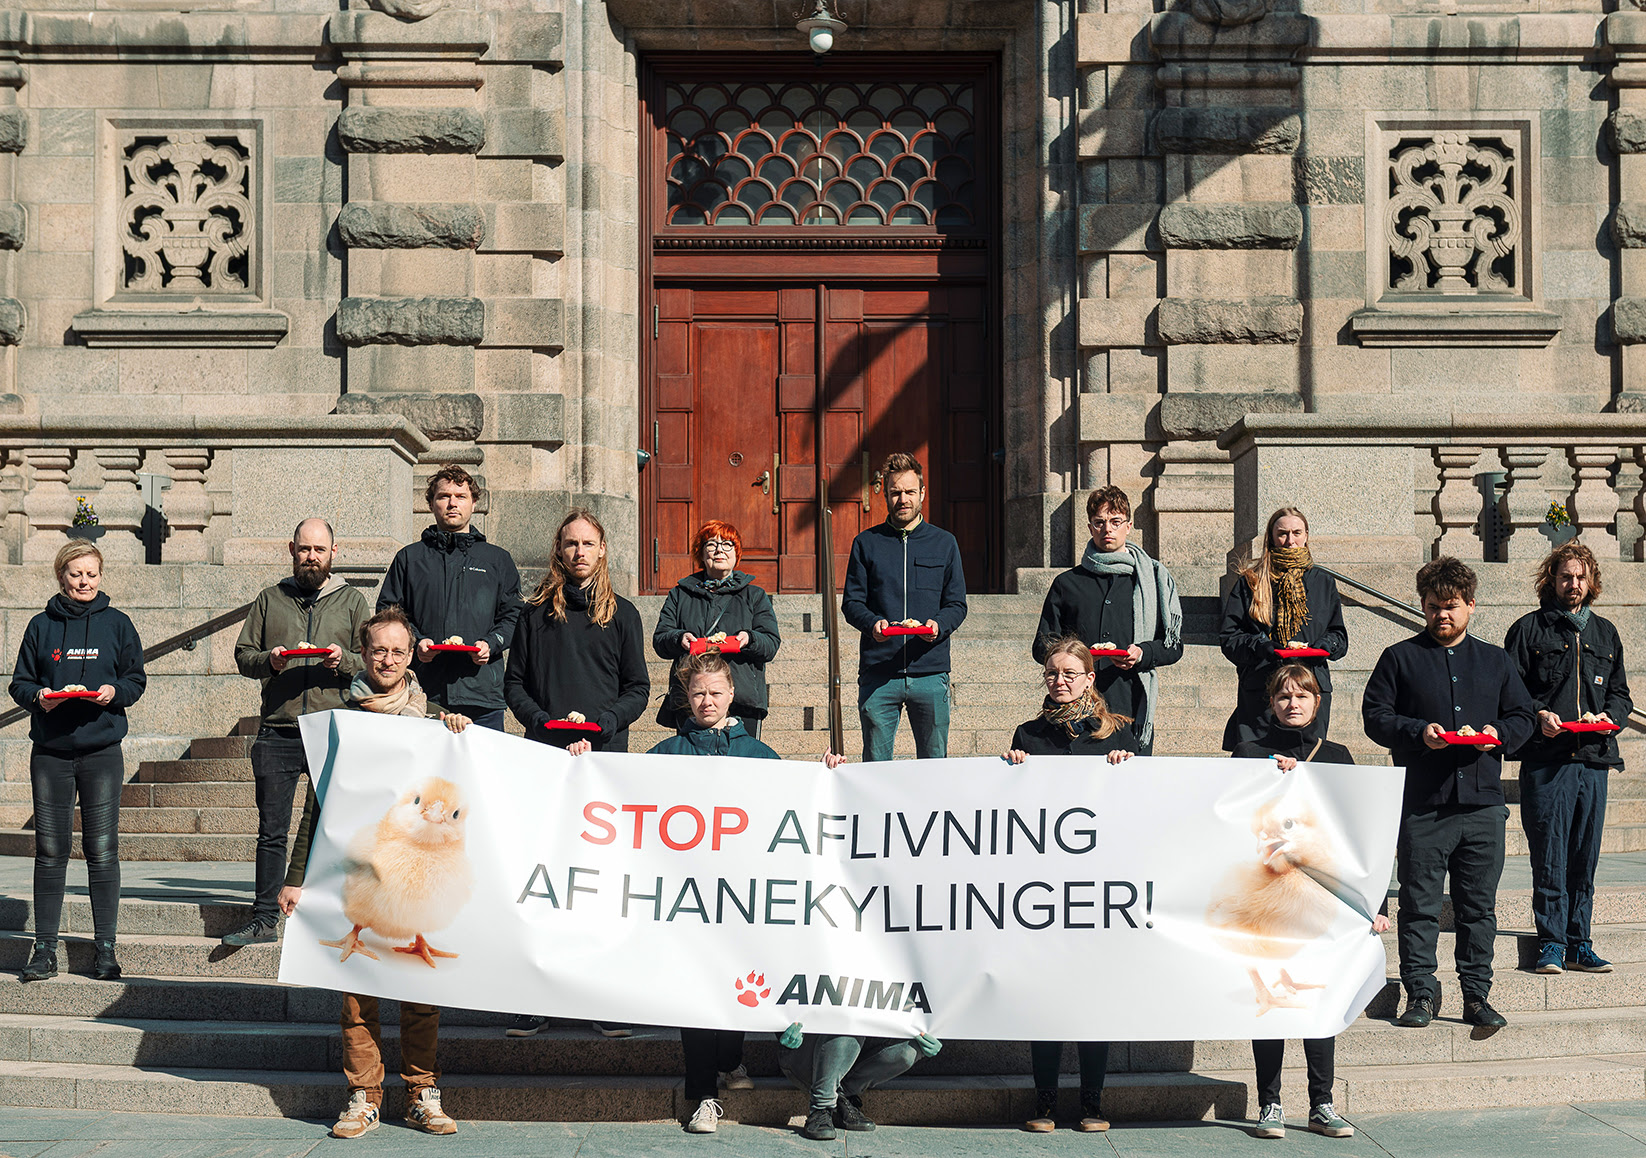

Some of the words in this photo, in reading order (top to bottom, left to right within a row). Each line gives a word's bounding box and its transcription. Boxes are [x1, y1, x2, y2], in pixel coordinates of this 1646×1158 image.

[580, 801, 749, 852] STOP
[767, 806, 1097, 860] AFLIVNING
[516, 863, 600, 912] AF
[621, 873, 1154, 933] HANEKYLLINGER!
[776, 973, 933, 1015] ANIMA
